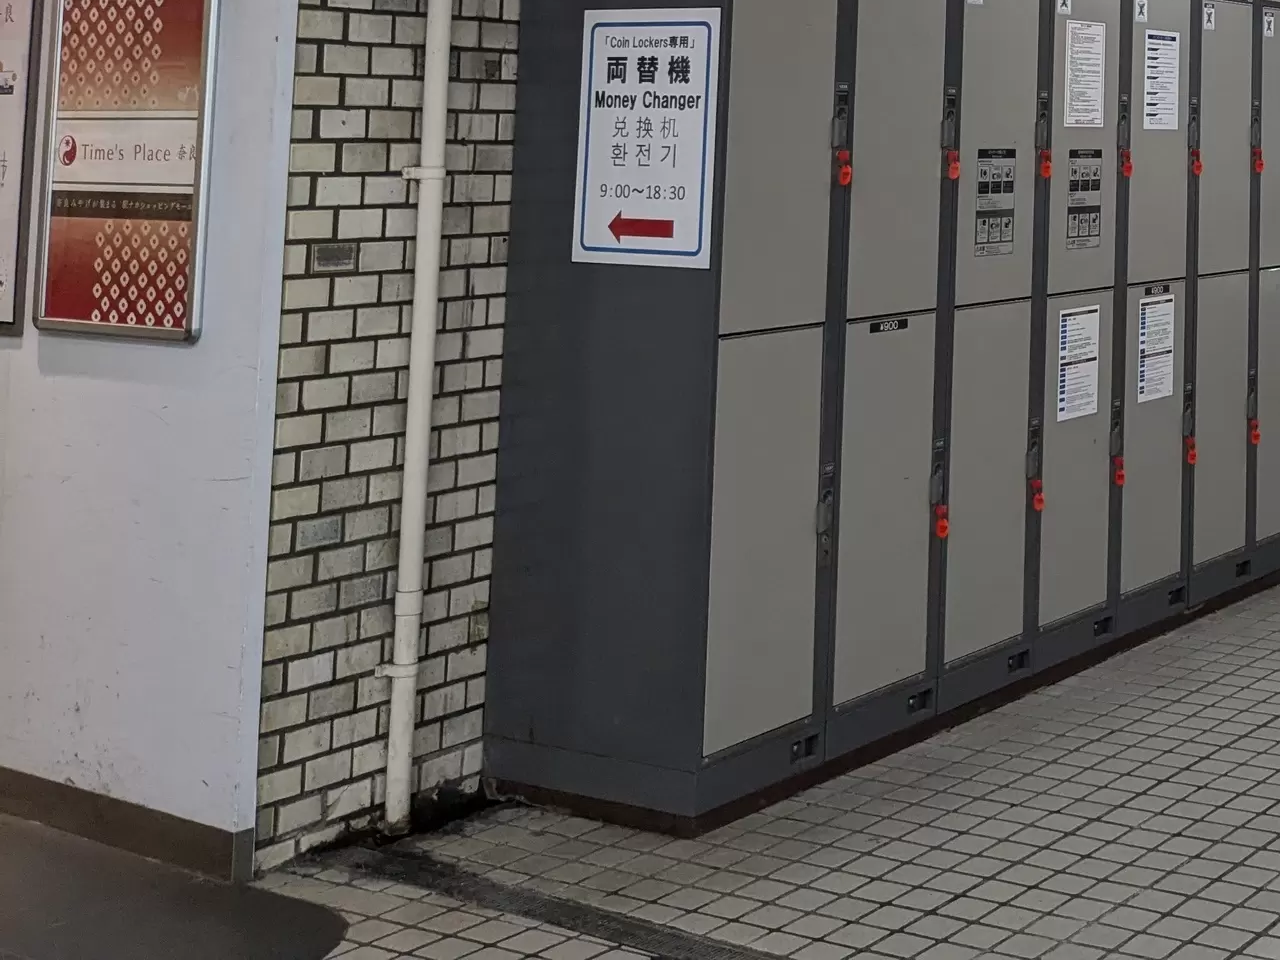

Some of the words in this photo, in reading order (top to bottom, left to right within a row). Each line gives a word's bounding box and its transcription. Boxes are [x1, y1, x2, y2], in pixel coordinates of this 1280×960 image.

[606, 56, 691, 84] 両替機
[594, 91, 637, 111] Money
[642, 90, 701, 110] Changer
[612, 117, 679, 139] 兑换机
[82, 143, 125, 161] Time's
[134, 143, 171, 161] Place
